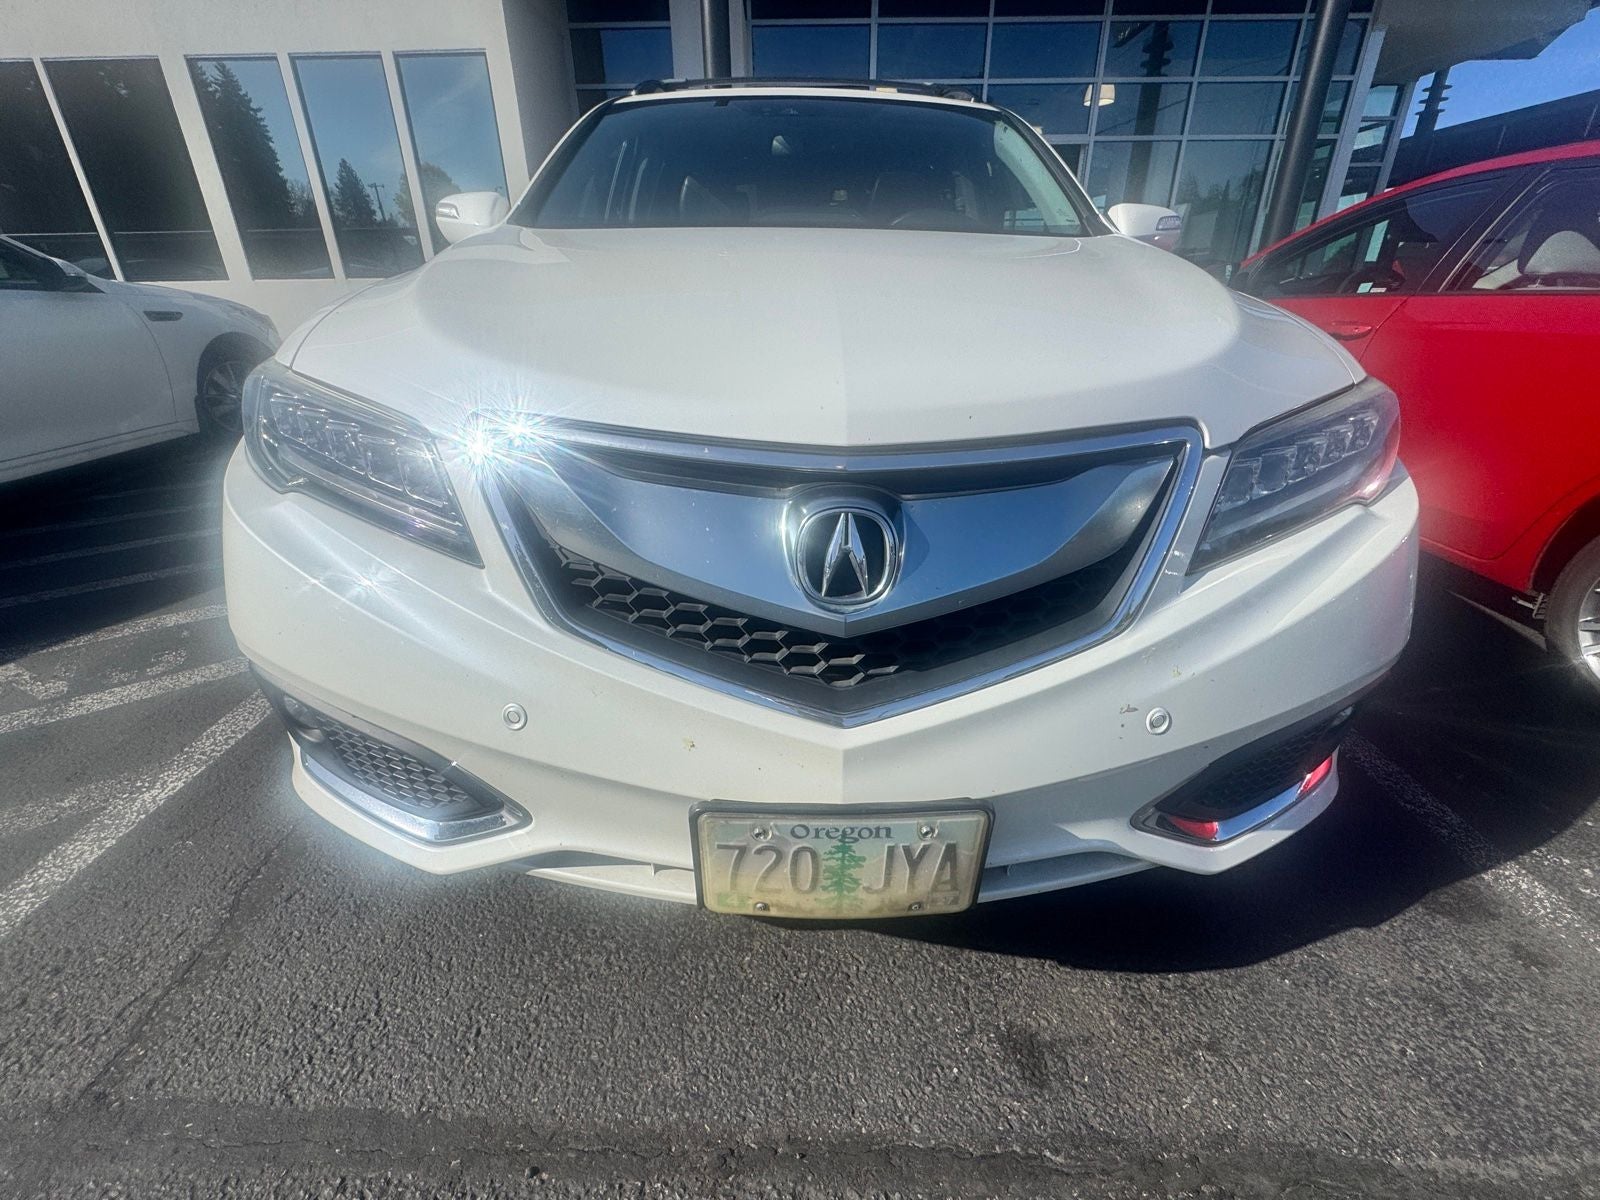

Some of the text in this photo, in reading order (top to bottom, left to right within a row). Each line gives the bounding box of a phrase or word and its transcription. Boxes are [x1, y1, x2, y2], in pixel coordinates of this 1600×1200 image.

[789, 824, 894, 843] Oregon
[717, 843, 960, 894] 720 JYA
